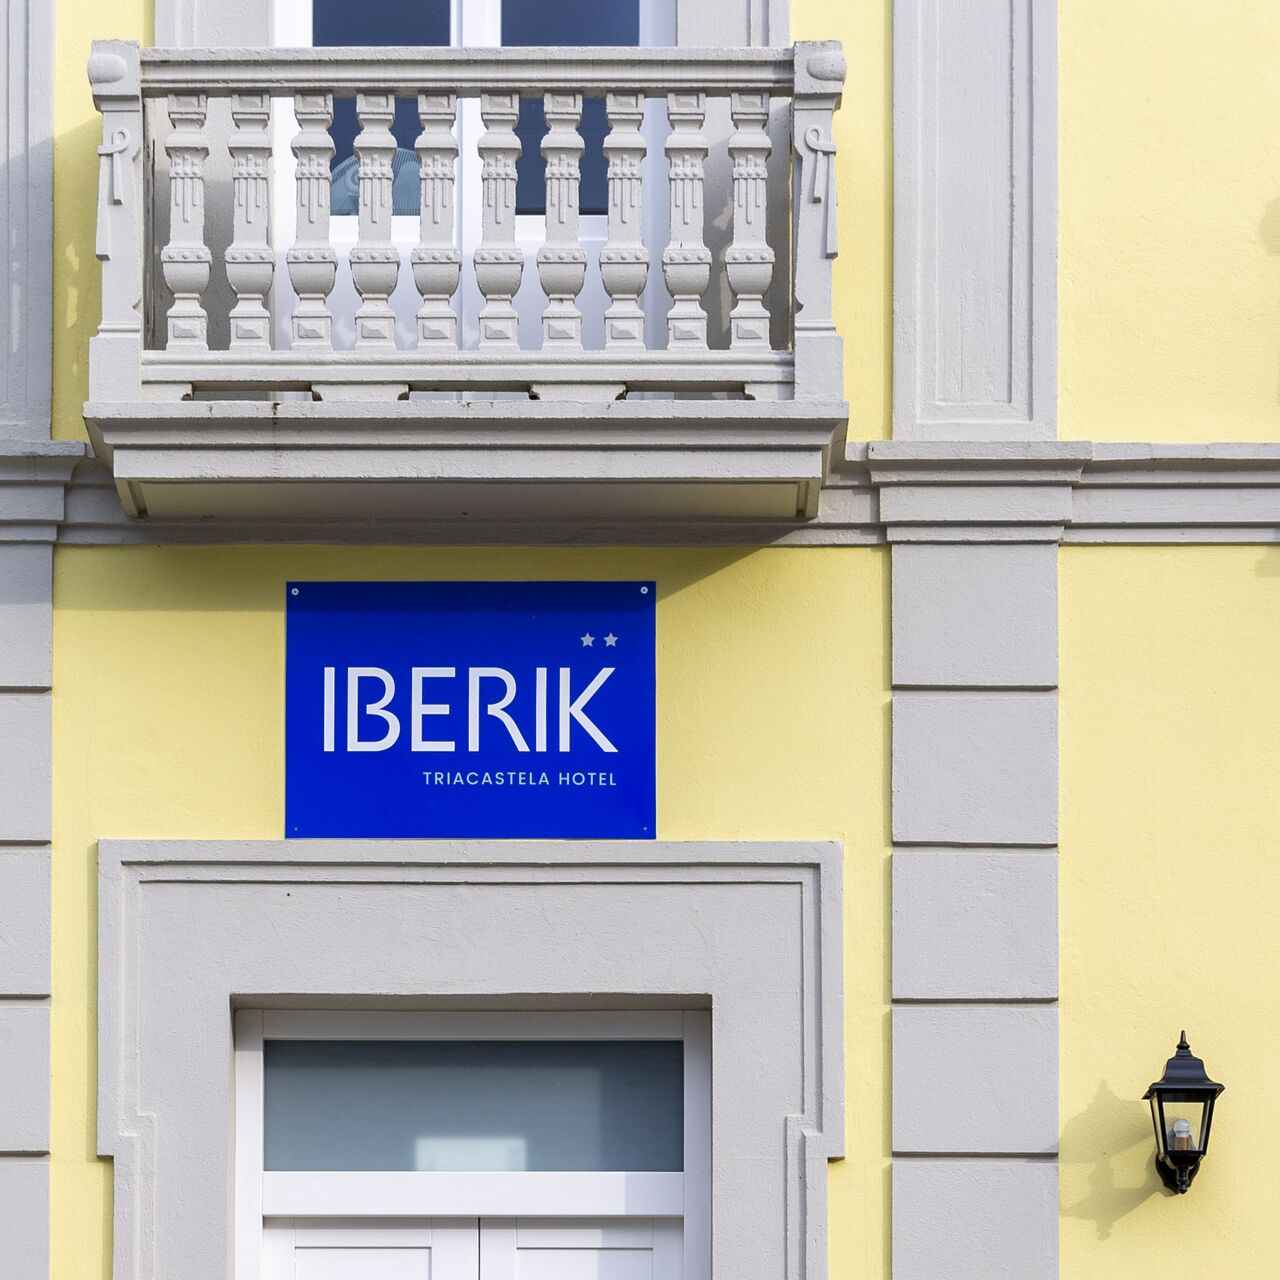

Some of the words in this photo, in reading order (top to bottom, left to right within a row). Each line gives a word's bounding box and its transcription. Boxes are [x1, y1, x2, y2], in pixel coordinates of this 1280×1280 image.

[323, 666, 619, 753] IBERIK
[422, 771, 550, 786] TRIACASTELA
[558, 772, 617, 787] HOTEL
